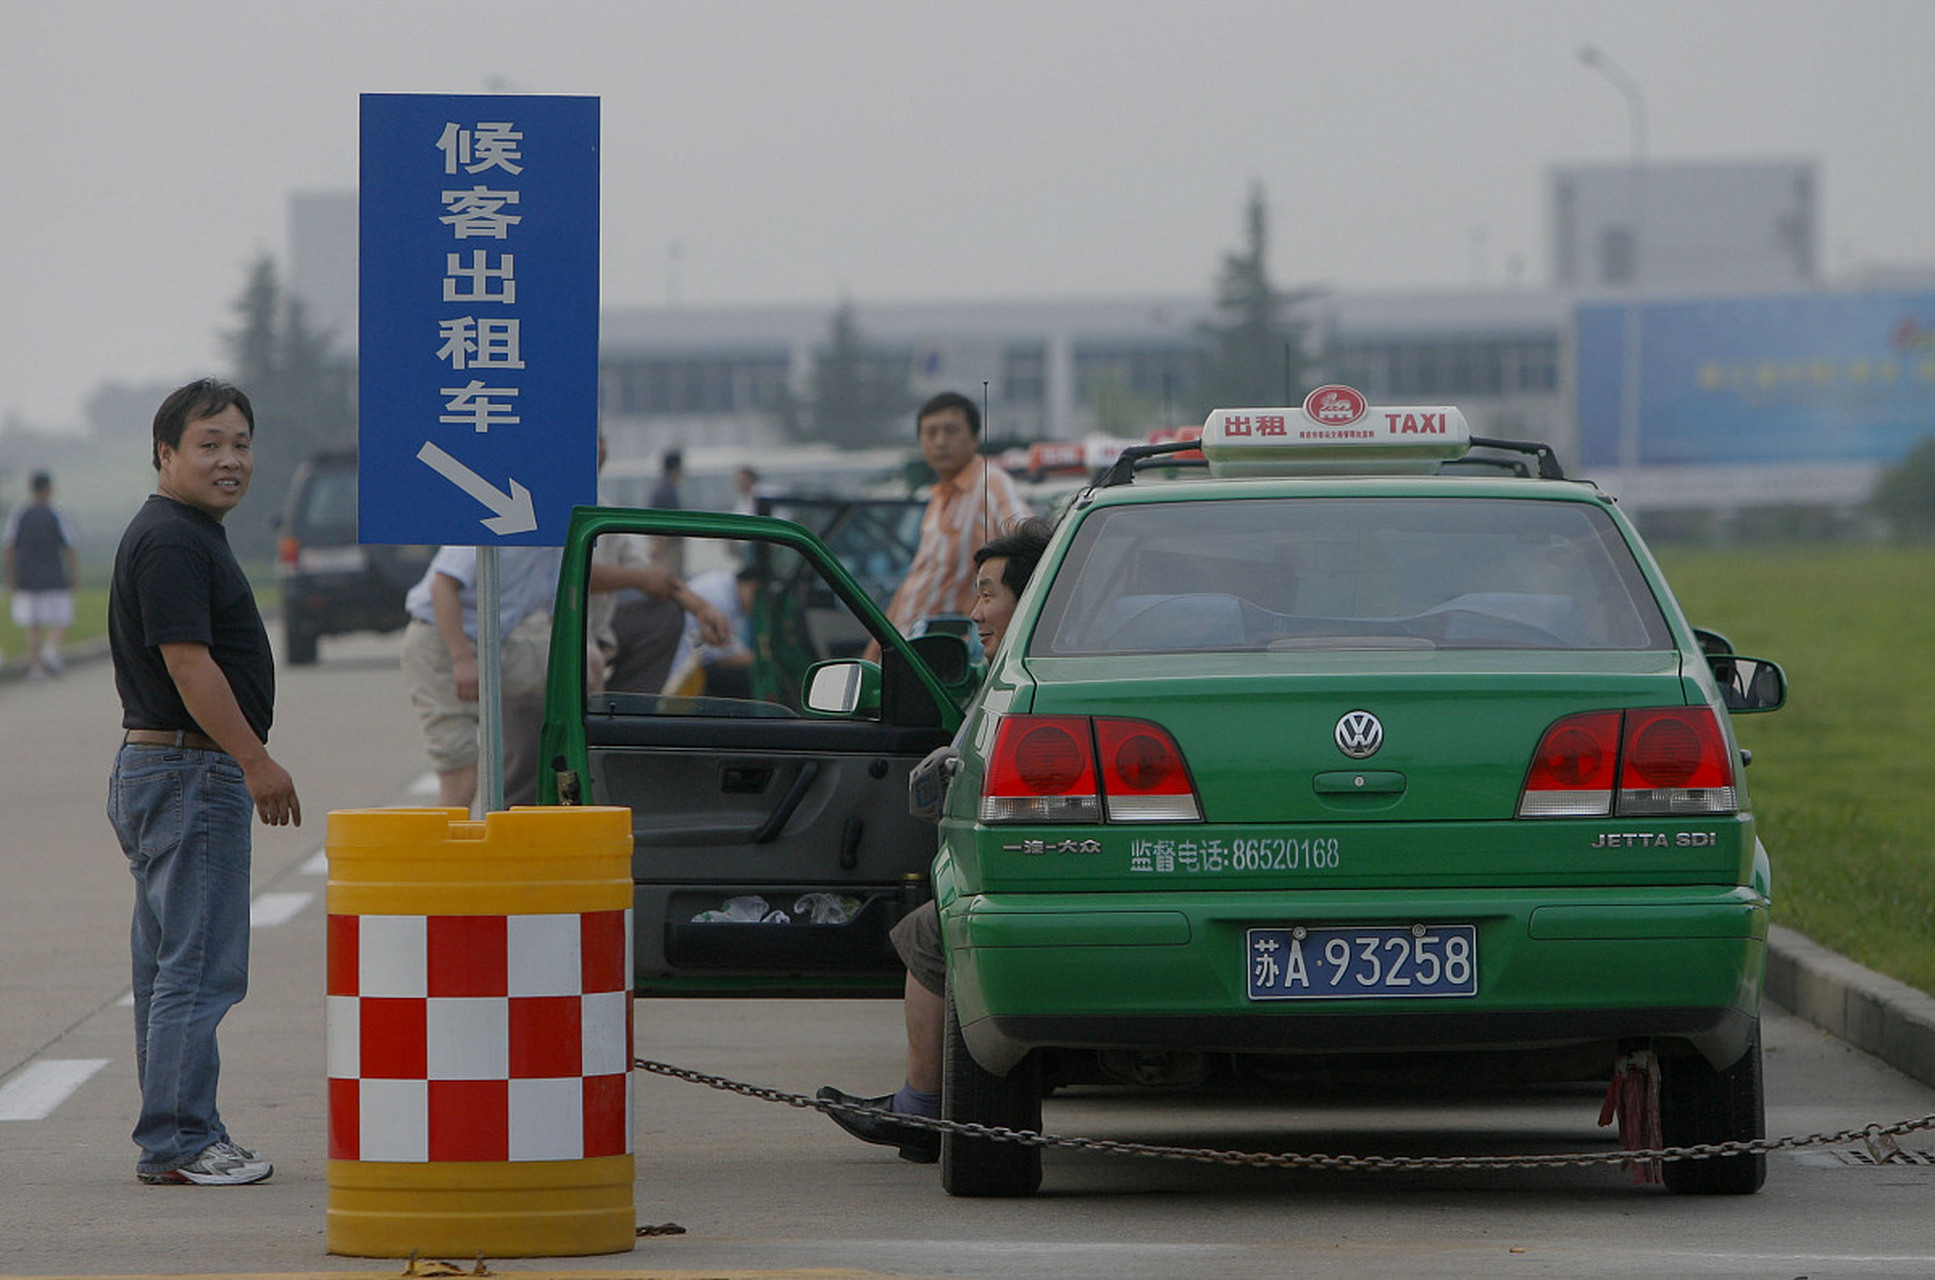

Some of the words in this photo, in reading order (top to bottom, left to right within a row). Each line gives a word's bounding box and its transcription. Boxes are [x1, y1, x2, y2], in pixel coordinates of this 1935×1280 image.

[436, 121, 525, 433] 候客出租车
[1224, 415, 1288, 437] 出租
[1384, 413, 1446, 434] TAXI
[1591, 832, 1669, 848] JETTA
[1675, 832, 1717, 847] SDI
